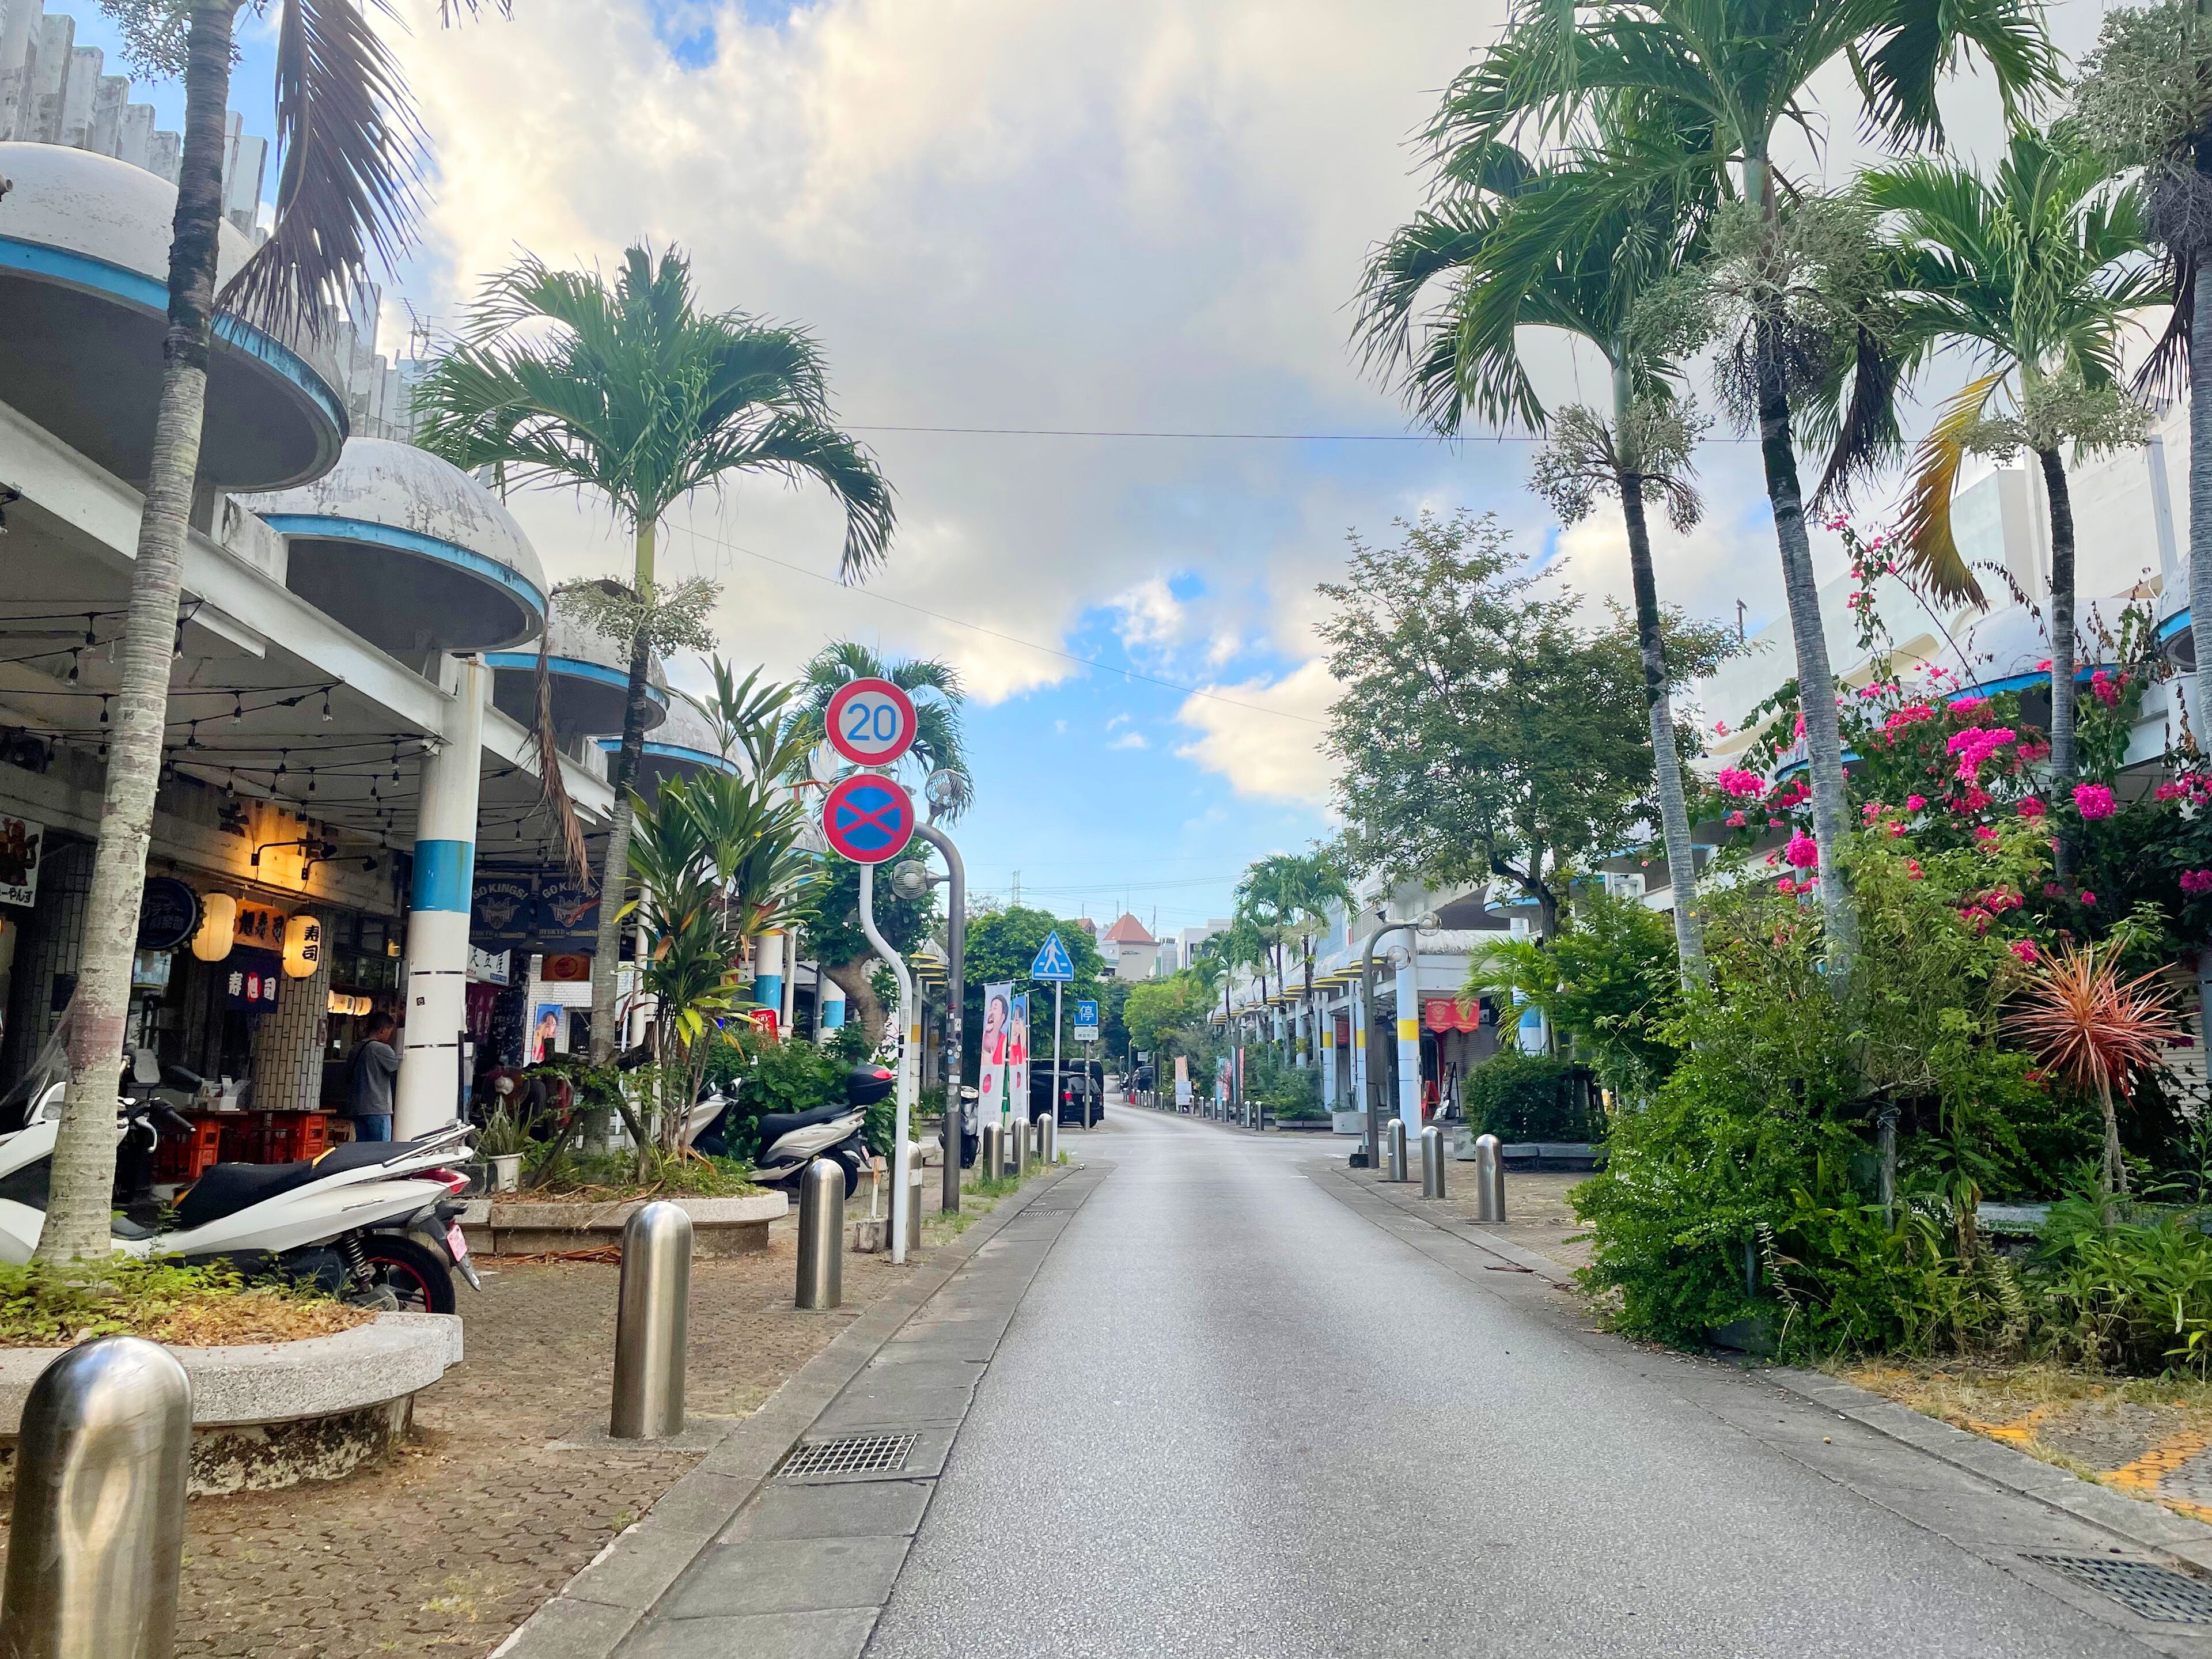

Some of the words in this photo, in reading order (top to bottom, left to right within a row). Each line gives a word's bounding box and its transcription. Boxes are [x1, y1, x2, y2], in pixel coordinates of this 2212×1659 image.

[847, 703, 896, 741] 20
[472, 886, 487, 900] GO
[542, 885, 558, 899] GO
[302, 925, 320, 962] 寿司
[1080, 1005, 1094, 1021] 停
